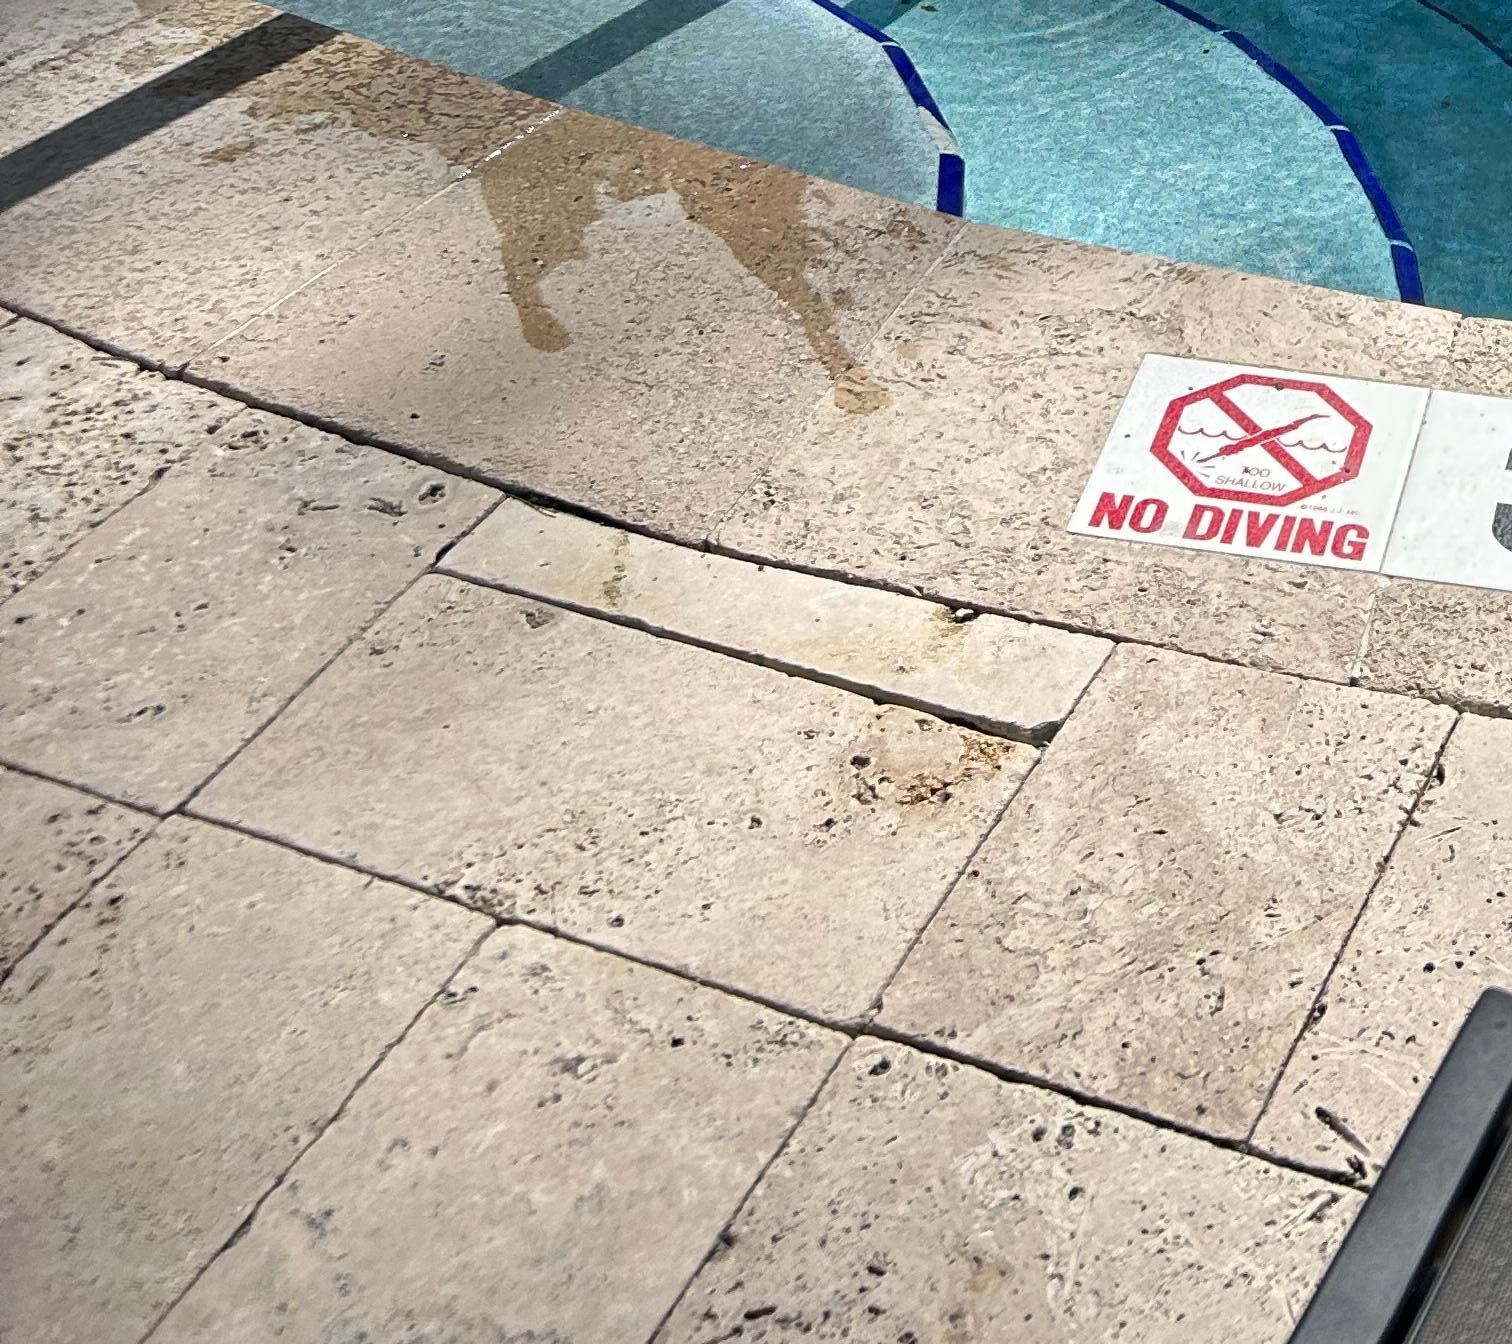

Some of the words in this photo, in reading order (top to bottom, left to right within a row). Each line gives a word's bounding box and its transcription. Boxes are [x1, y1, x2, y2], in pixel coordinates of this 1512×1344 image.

[1241, 465, 1271, 478] TOO
[1214, 475, 1288, 492] SHALLOW
[1088, 491, 1170, 534] NO
[1181, 503, 1370, 562] DIVING
